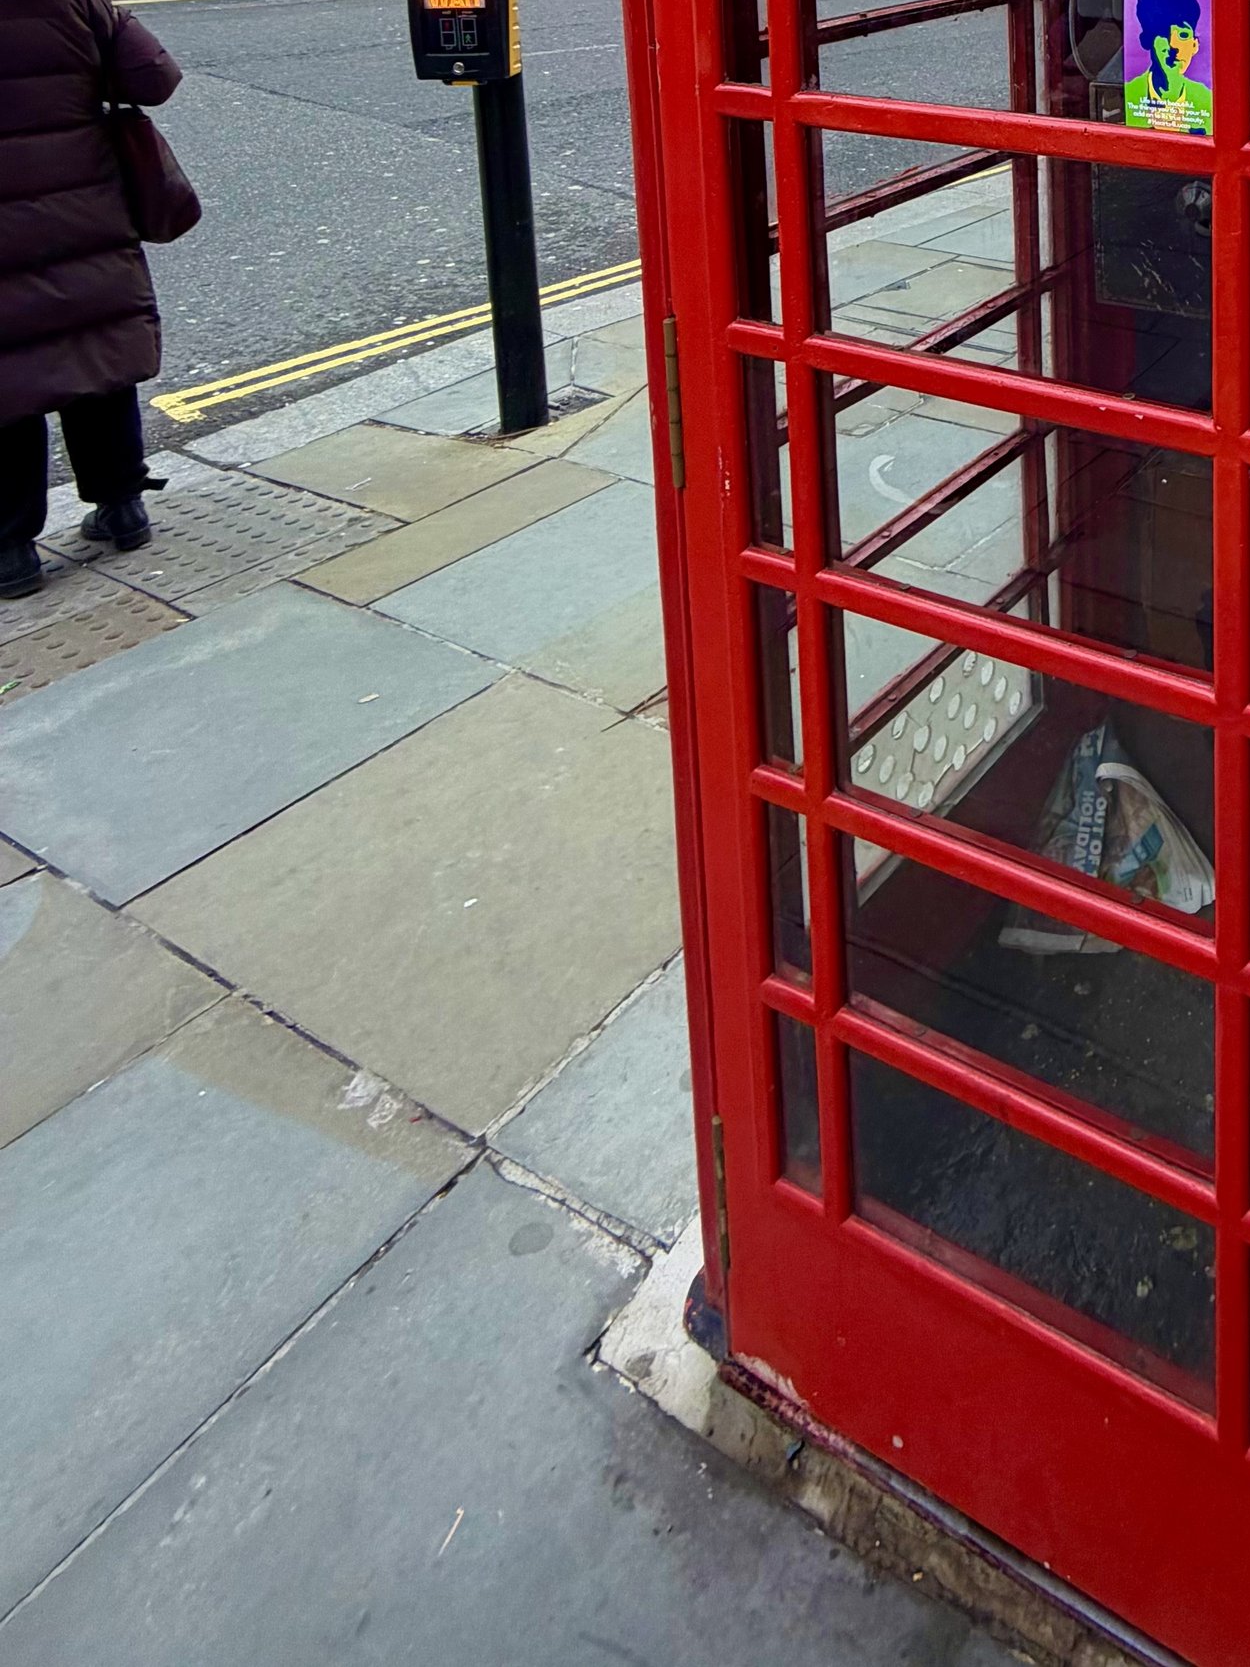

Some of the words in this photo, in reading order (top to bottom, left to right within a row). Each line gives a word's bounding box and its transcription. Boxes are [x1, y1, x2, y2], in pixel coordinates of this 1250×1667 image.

[1139, 104, 1157, 113] things
[1201, 109, 1210, 117] life
[1093, 797, 1108, 836] OUT
[1088, 838, 1103, 868] OF
